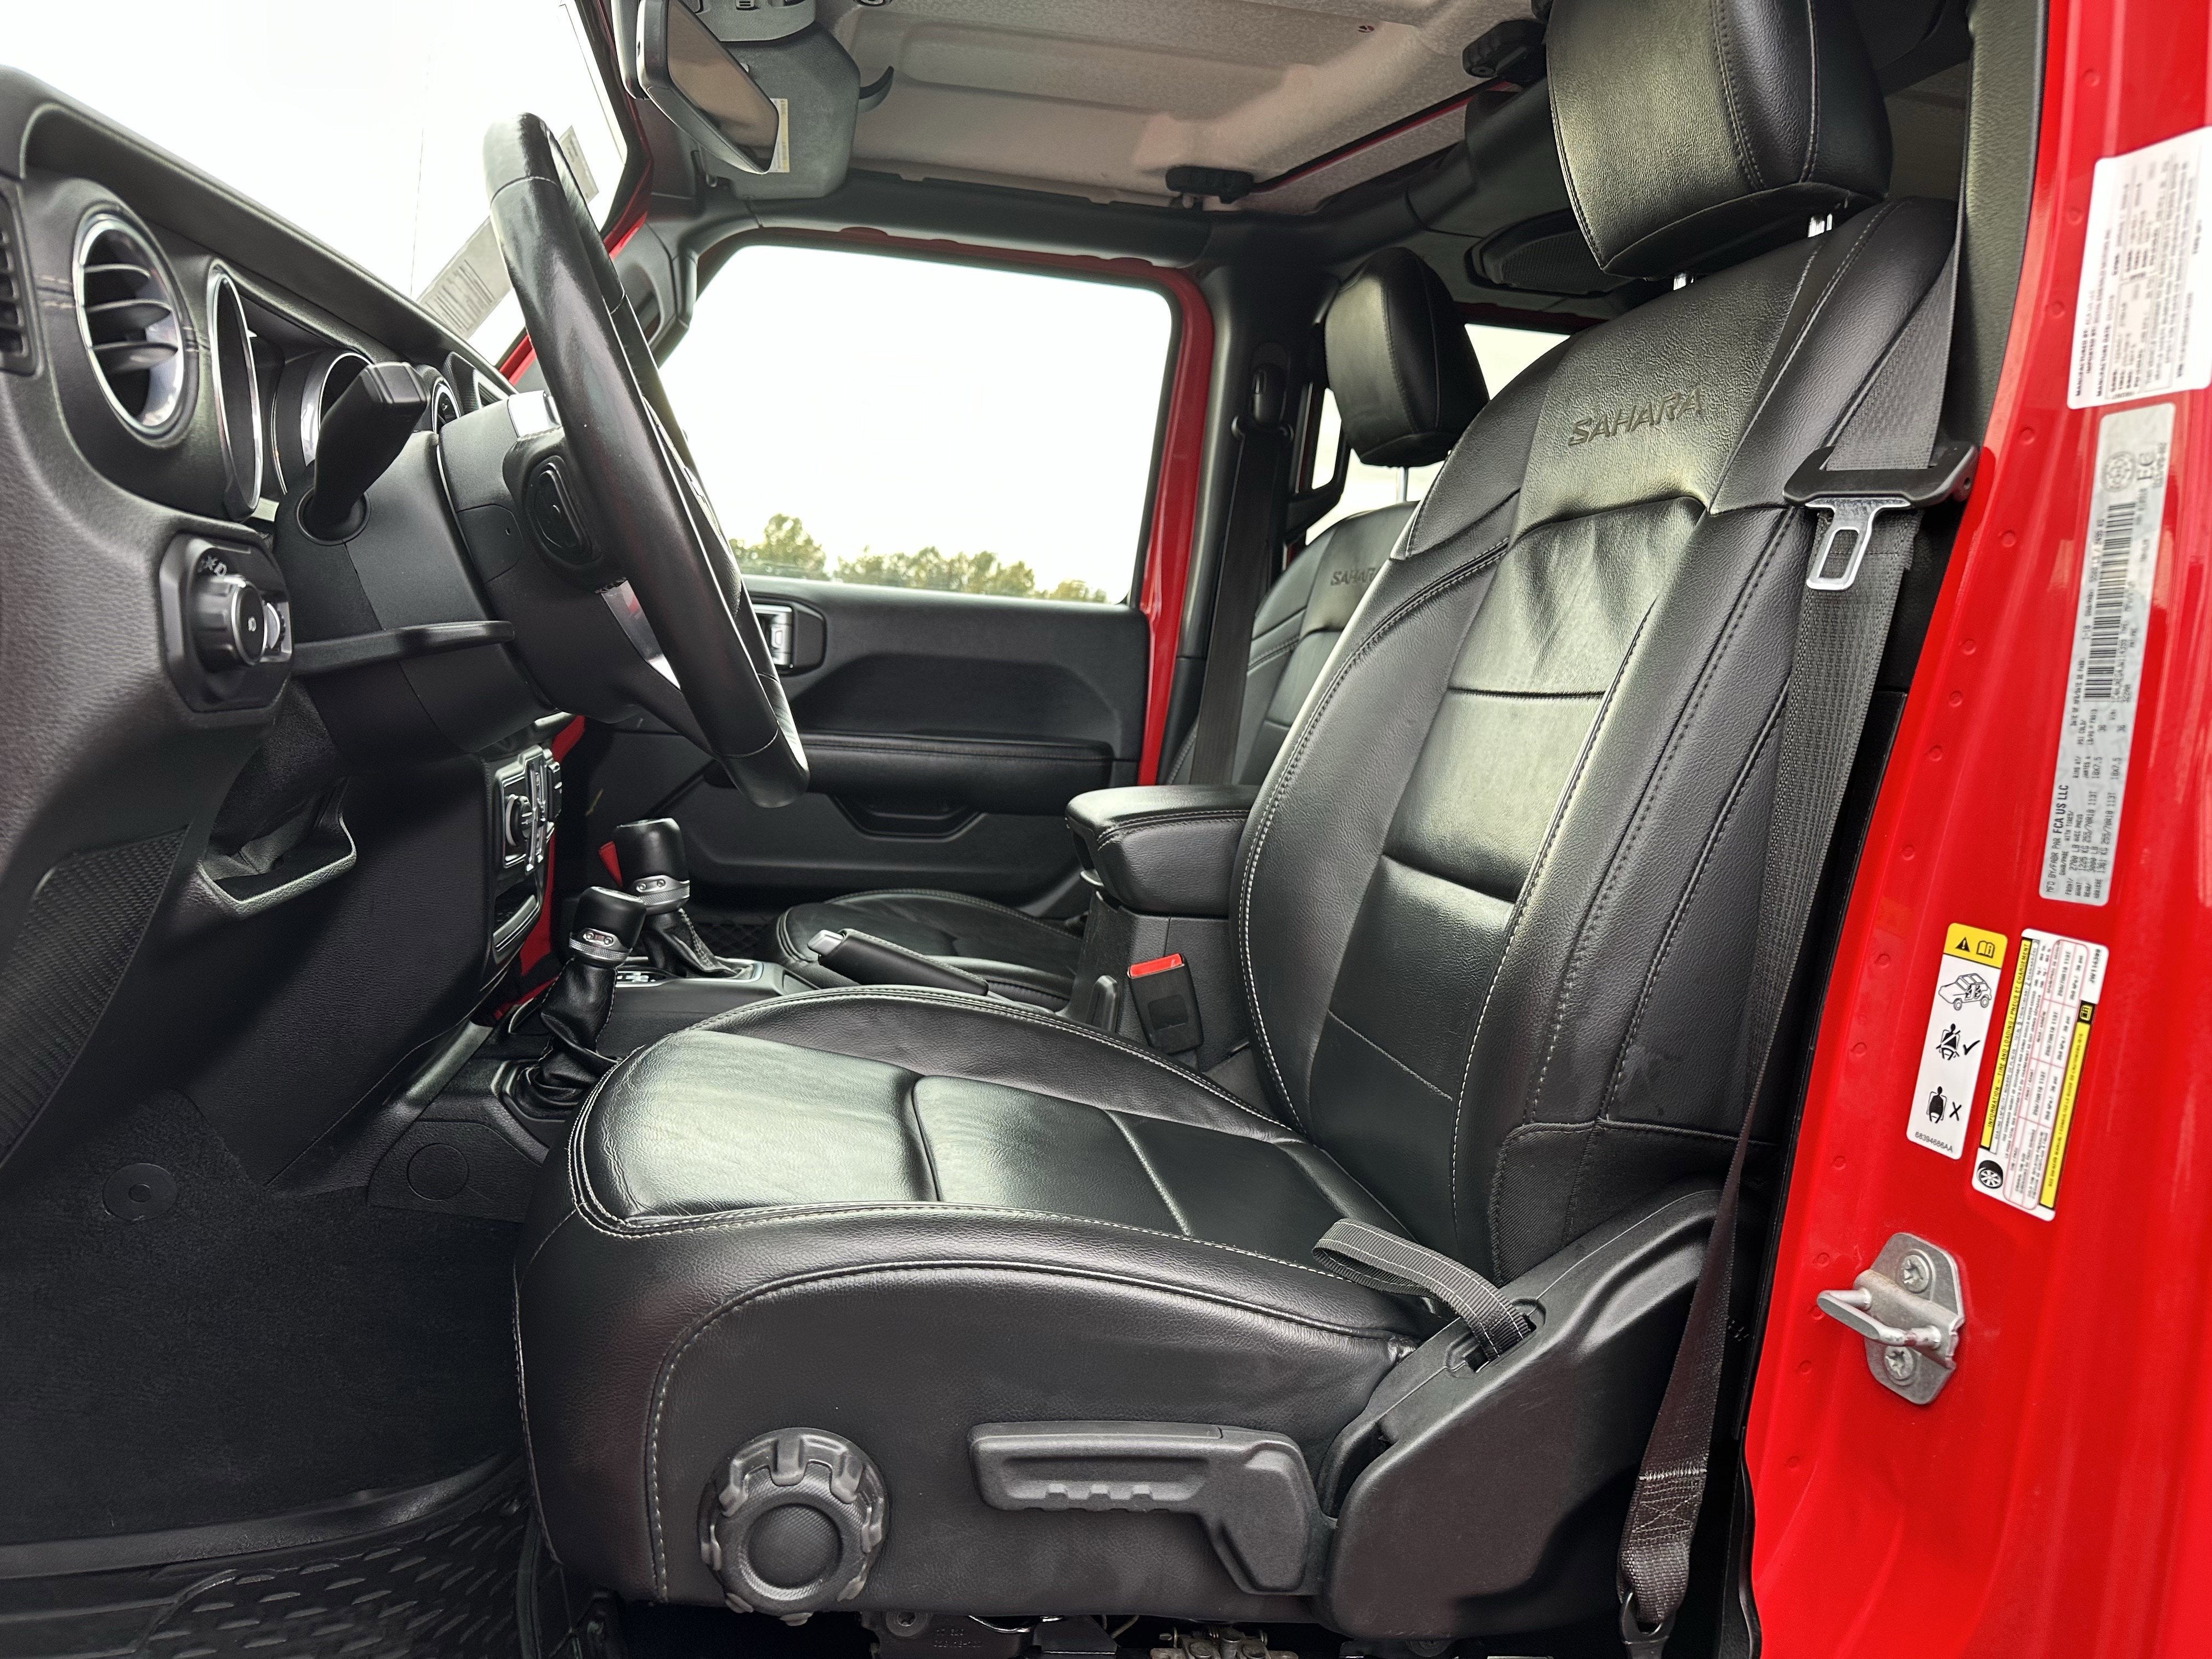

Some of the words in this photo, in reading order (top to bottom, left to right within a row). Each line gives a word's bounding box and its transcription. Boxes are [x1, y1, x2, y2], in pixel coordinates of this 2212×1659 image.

[1567, 386, 1703, 446] SAHARA
[1330, 567, 1376, 586] SAHAR
[2057, 785, 2069, 800] LLC
[2056, 803, 2066, 814] US
[2052, 817, 2064, 833] FCA
[2051, 837, 2061, 849] PAR
[1987, 1086, 2000, 1127] INFORMATION
[2003, 1020, 2013, 1047] LOADING
[2010, 995, 2018, 1015] PNEUS
[2016, 944, 2028, 984] CHARGEMENT
